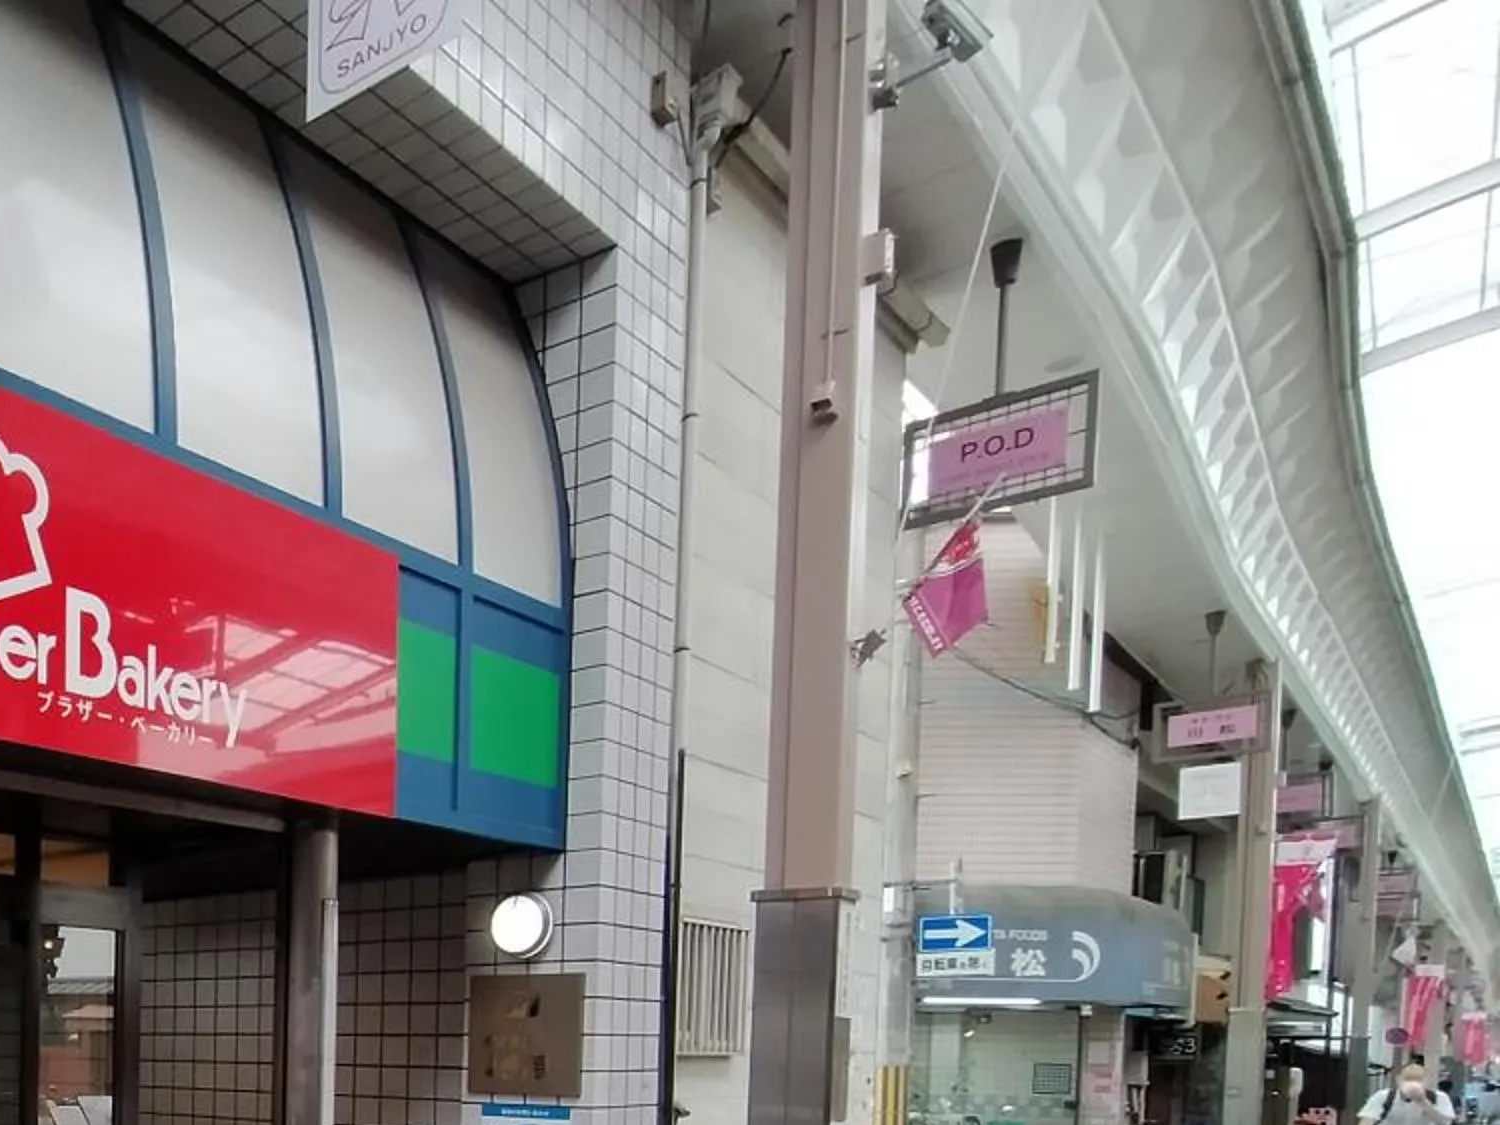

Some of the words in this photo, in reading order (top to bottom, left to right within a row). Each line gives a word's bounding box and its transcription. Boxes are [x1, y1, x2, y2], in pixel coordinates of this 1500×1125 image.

[336, 13, 428, 79] SANJYO
[960, 427, 1035, 463] P.O.D
[65, 586, 248, 748] Bakery
[36, 690, 215, 746] ブラザー・ベーカリー
[1010, 948, 1047, 977] 松
